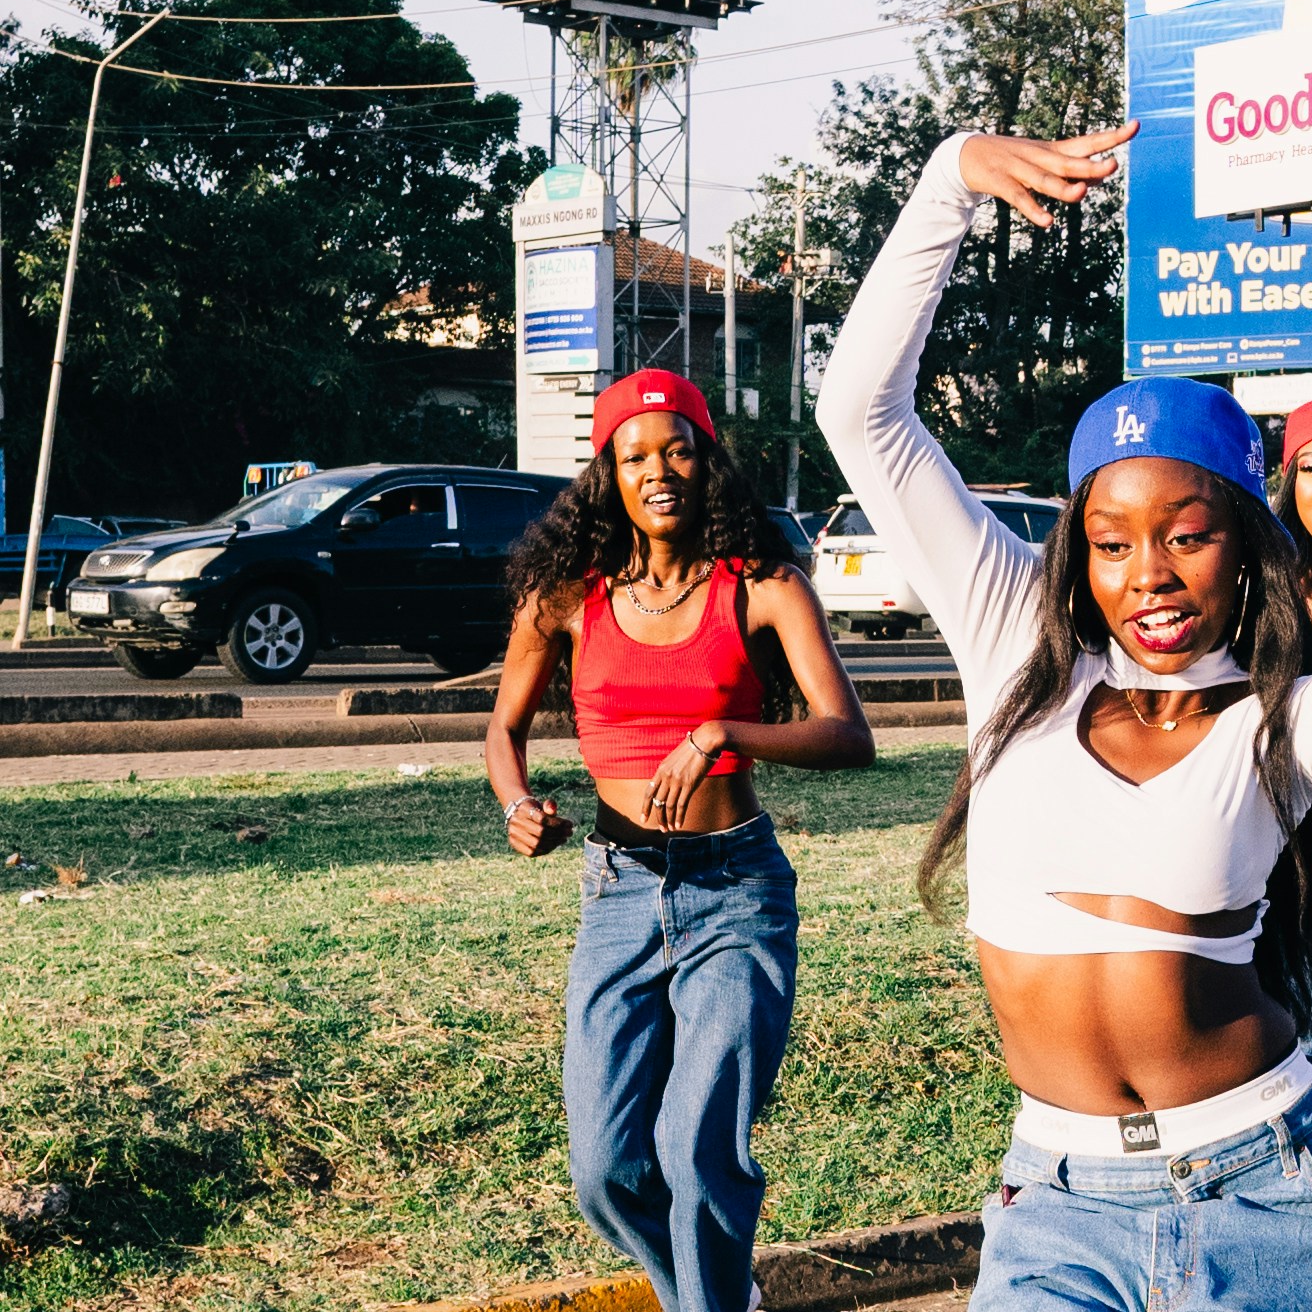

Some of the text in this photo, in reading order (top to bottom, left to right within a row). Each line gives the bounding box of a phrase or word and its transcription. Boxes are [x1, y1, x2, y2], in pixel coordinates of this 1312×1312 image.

[1228, 149, 1285, 168] Pharmacy
[520, 207, 598, 227] MAXXIS NGONG RD
[539, 257, 589, 275] HAZINA
[1158, 247, 1219, 282] Pay
[1226, 242, 1307, 274] Your
[1159, 281, 1232, 317] with
[1113, 405, 1146, 447] LA
[1260, 1075, 1293, 1101] GM
[1123, 1124, 1158, 1143] GM
